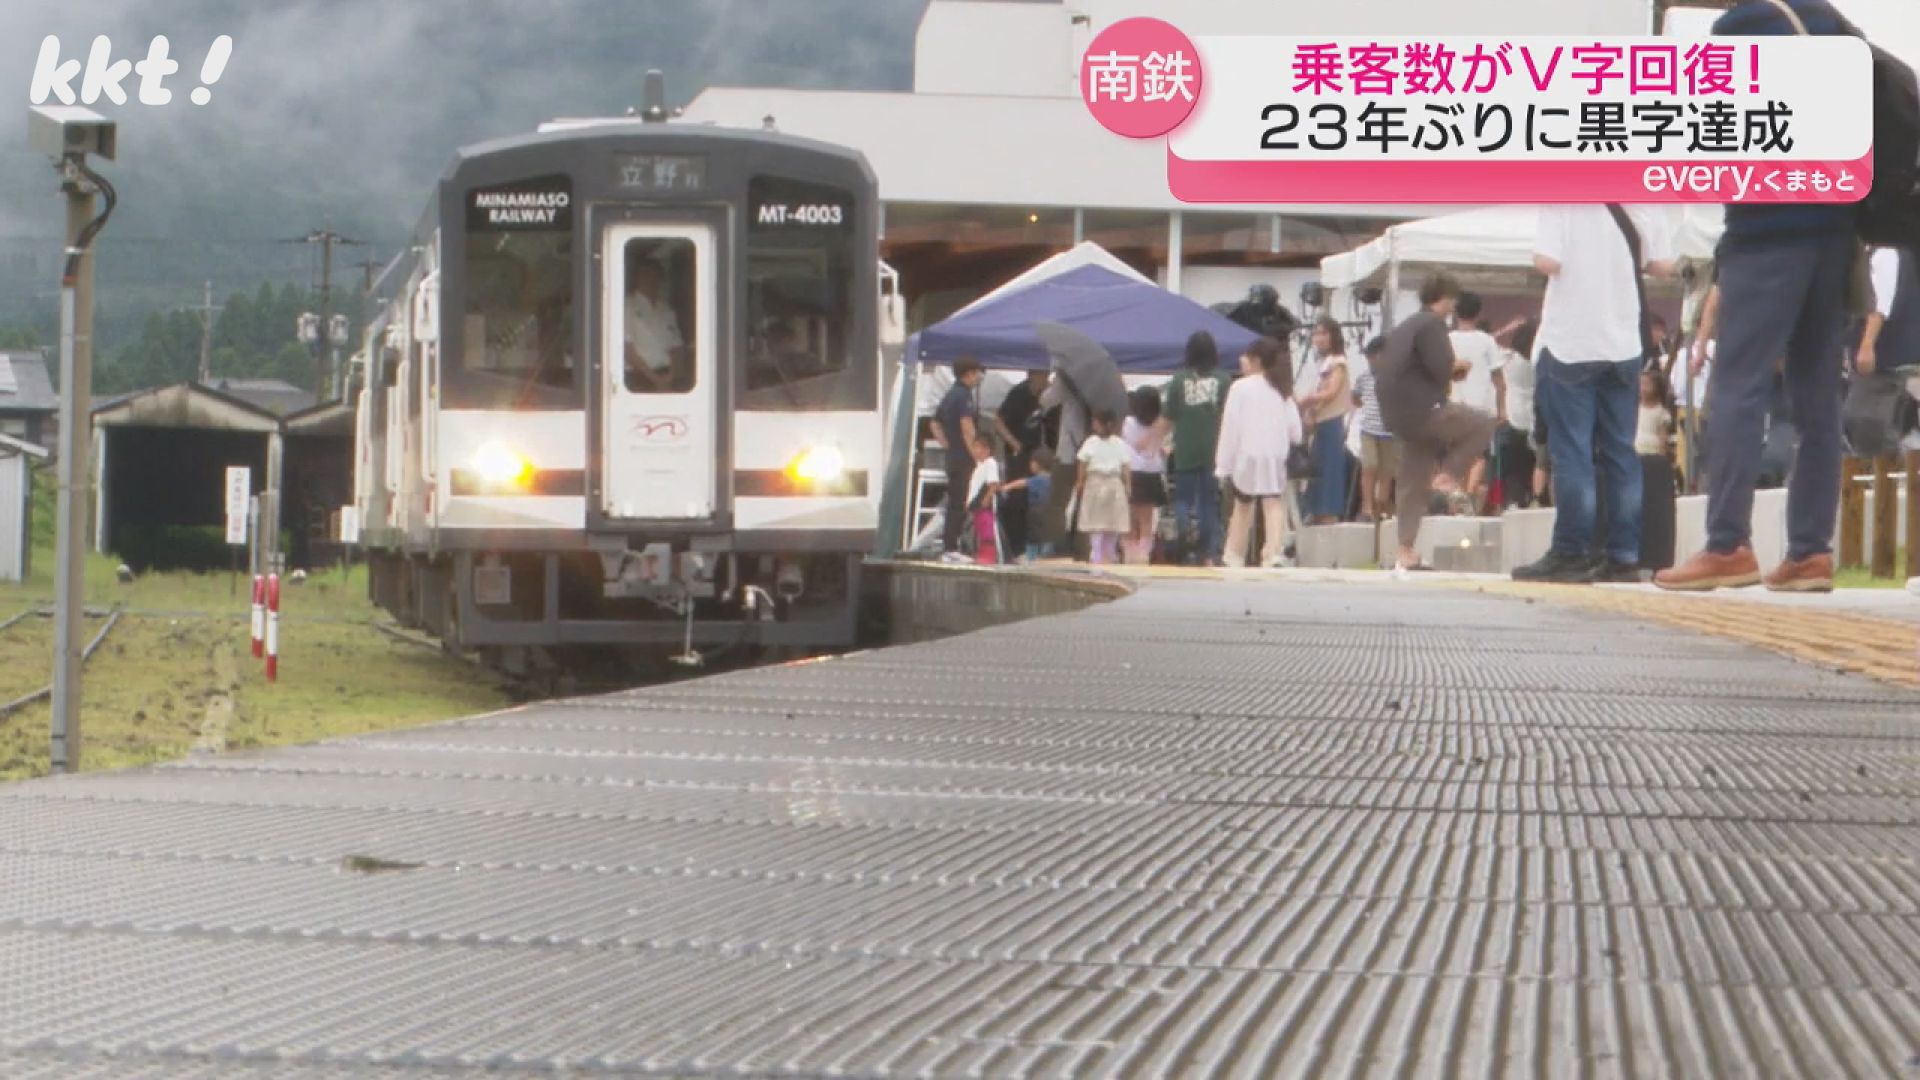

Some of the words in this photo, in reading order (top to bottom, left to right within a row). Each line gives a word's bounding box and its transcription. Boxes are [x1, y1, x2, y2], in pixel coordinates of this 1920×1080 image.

[476, 192, 569, 208] MINAMIASO
[488, 208, 556, 222] RAILWAY
[759, 204, 842, 223] MT-4003
